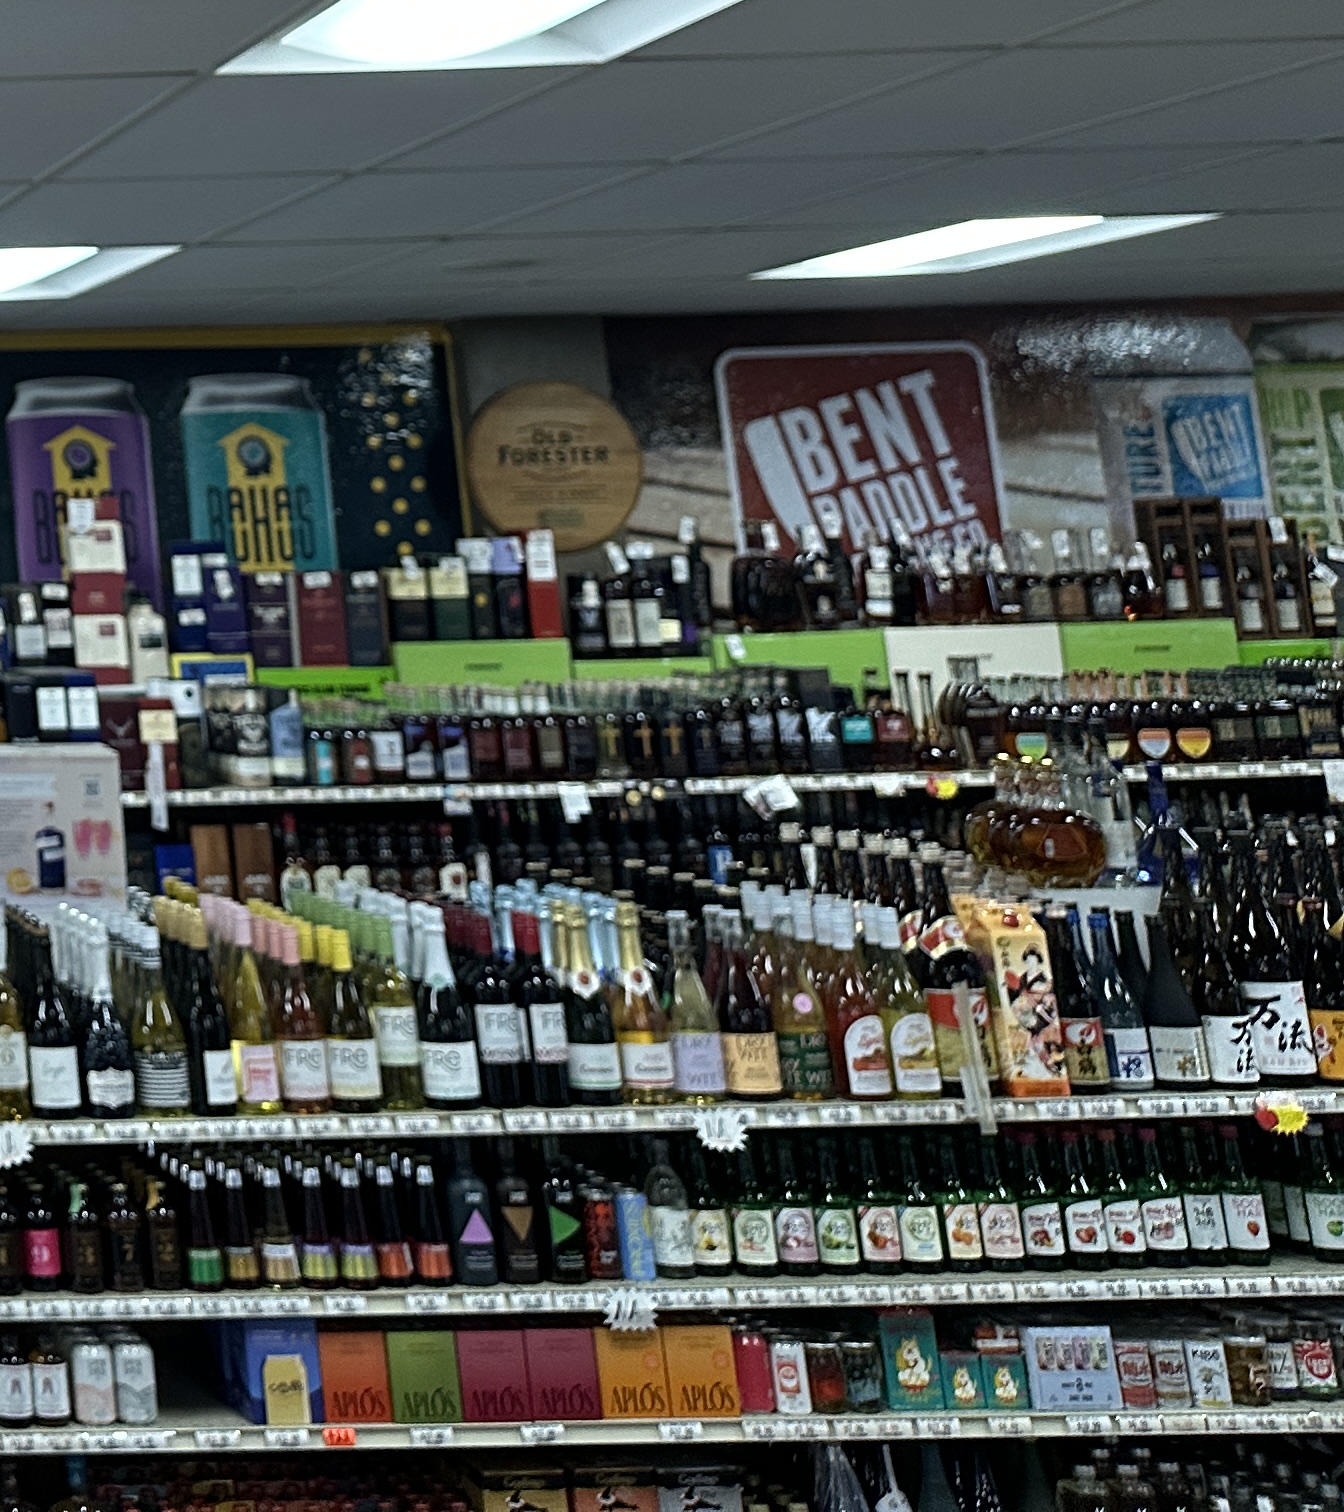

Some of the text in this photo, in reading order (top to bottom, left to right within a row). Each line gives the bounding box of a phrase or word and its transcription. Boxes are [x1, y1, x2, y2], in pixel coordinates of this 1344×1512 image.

[531, 428, 573, 445] OLD
[778, 368, 952, 494] BENT
[498, 444, 609, 467] FORESTER
